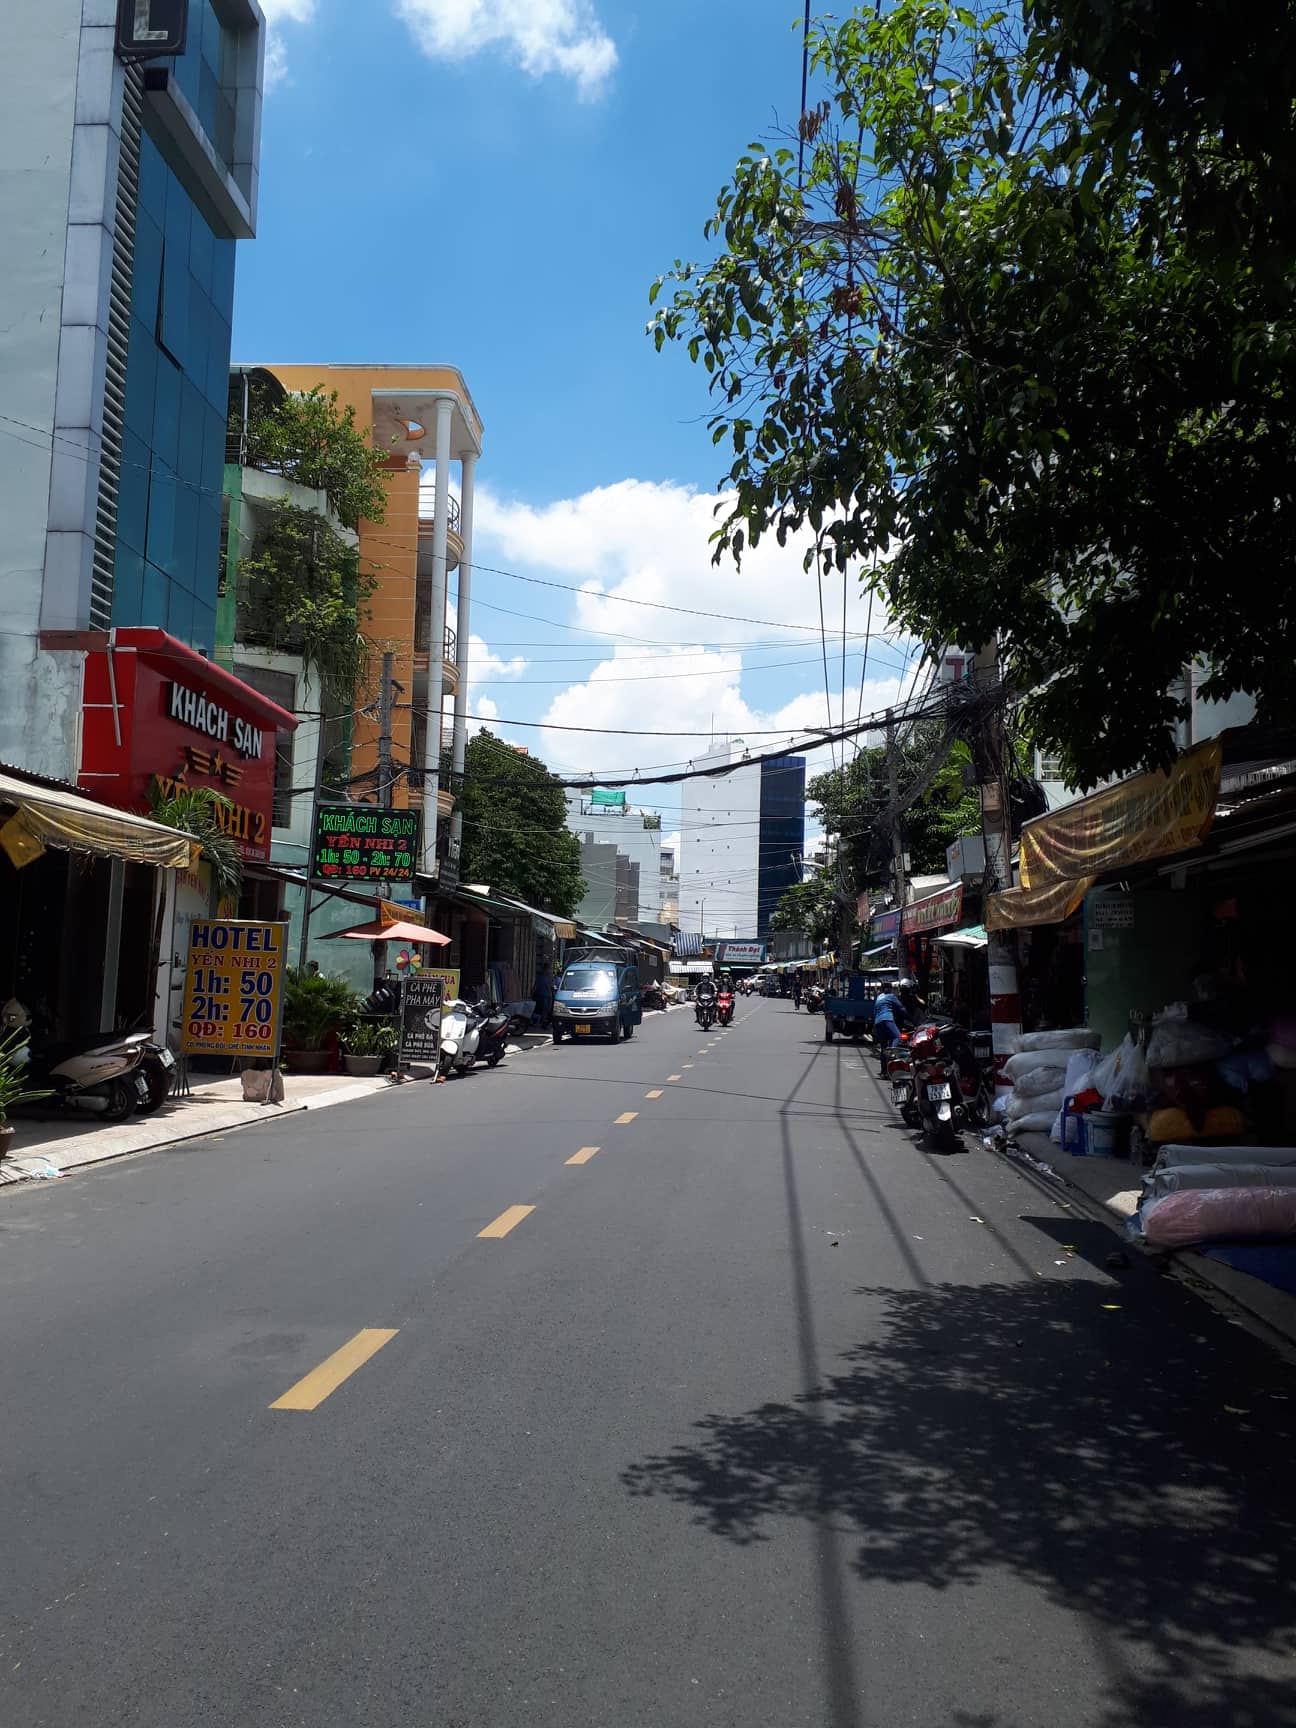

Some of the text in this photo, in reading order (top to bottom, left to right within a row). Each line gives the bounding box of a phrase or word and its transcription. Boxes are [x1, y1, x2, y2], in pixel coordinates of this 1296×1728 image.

[133, 0, 169, 41] L
[171, 682, 263, 760] KHÁCH SẠN
[214, 800, 249, 839] NHI
[255, 812, 266, 844] 2
[323, 812, 414, 837] KHÁCH SẠN
[326, 833, 408, 851] YẾN NHI 2
[320, 848, 340, 864] 1h:
[343, 849, 360, 865] 50
[370, 850, 391, 866] 2h:
[394, 852, 411, 867] 70
[345, 865, 367, 875] 160
[369, 867, 381, 876] PV
[191, 924, 279, 953] HOTEL
[191, 950, 278, 969] YẾN NHI 2
[192, 968, 273, 996] 1h: 50
[190, 995, 272, 1023] 2h: 70
[188, 1021, 272, 1040] QĐ: 160
